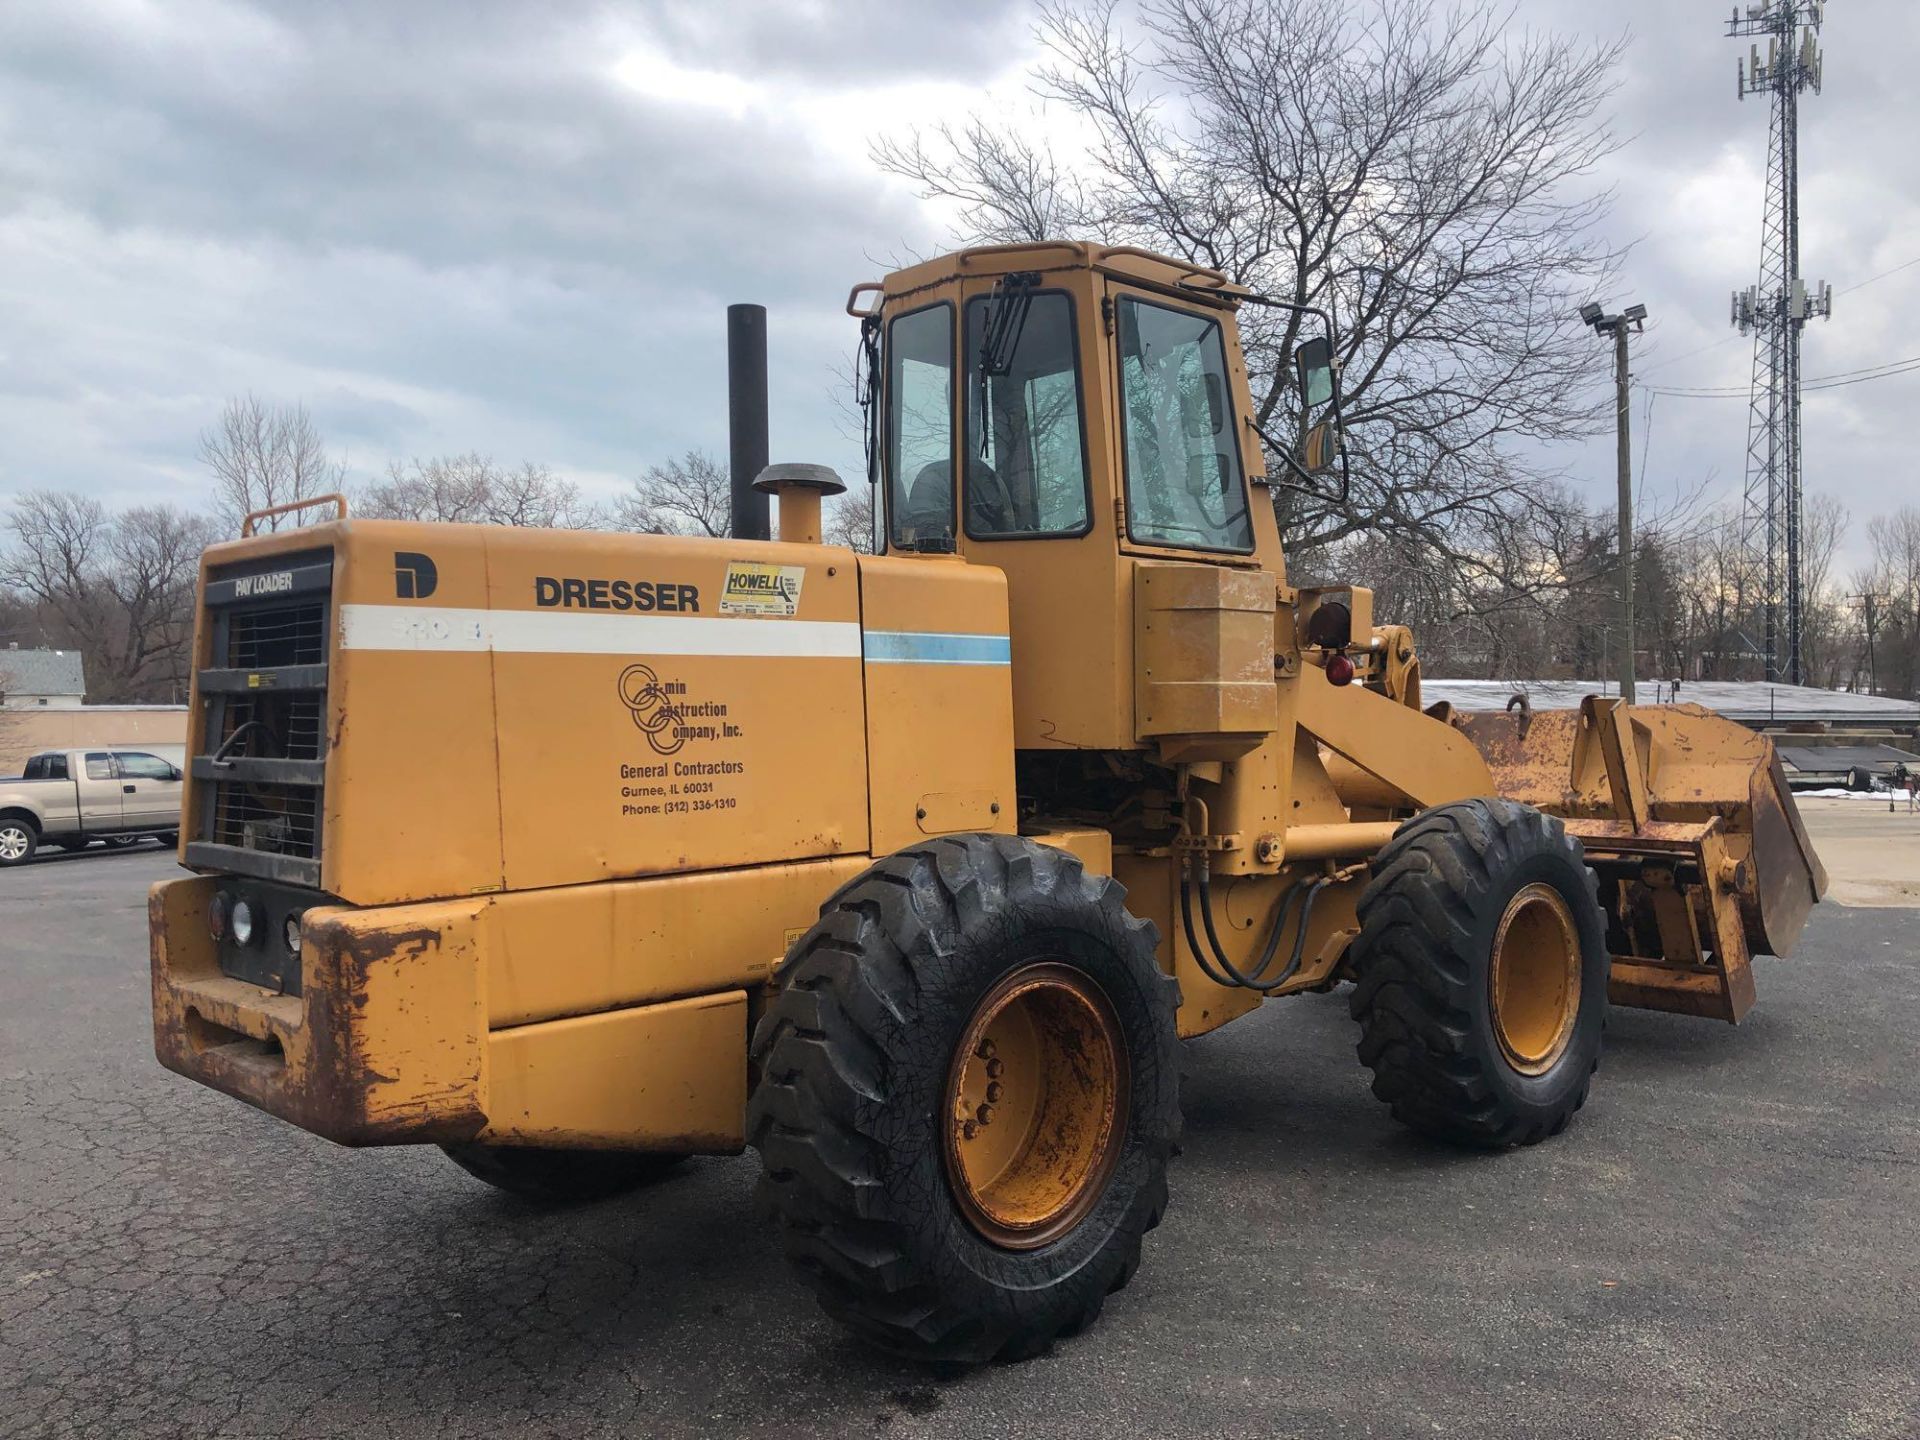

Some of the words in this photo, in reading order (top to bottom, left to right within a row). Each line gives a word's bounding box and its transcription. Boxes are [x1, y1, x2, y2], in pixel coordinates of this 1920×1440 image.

[727, 572, 780, 591] HOWELL
[535, 576, 700, 613] DRESSER
[723, 722, 743, 737] Inc.
[620, 763, 668, 779] General
[674, 760, 744, 777] Contractors
[621, 786, 667, 798] Gurnee,
[670, 784, 680, 795] IL
[683, 782, 713, 794] 60031
[622, 804, 661, 816] Phone:
[664, 801, 689, 815] (312)
[692, 798, 736, 811] 336-1310
